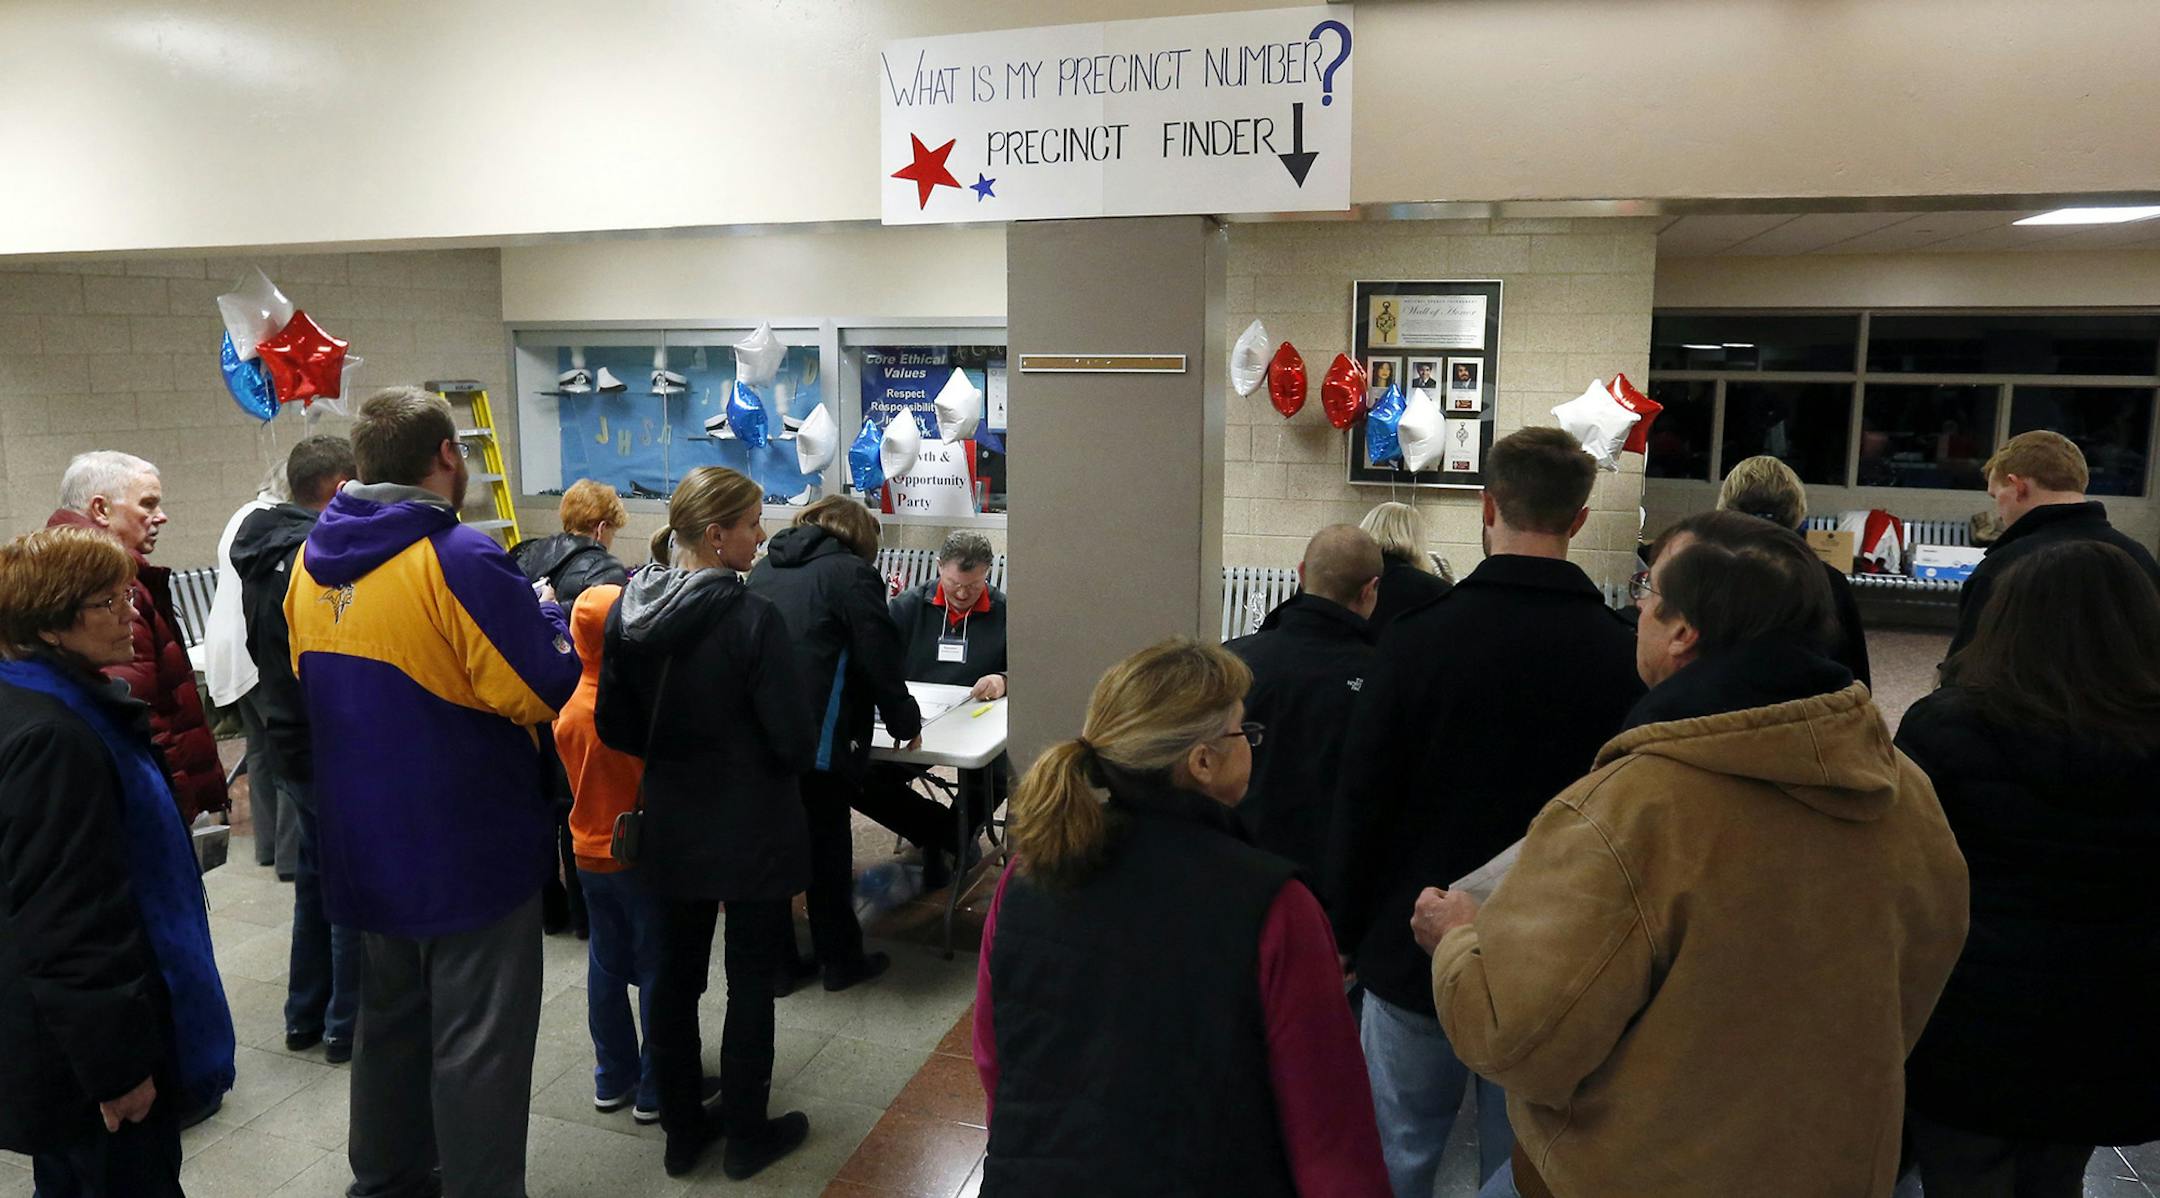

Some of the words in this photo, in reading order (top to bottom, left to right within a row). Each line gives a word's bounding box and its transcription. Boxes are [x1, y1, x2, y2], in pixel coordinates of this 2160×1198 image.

[881, 49, 961, 106] WHAT
[973, 65, 995, 102] IS
[1006, 61, 1043, 100] MY
[1058, 49, 1191, 96] PRECINCT
[987, 124, 1129, 166] PRECINCT
[1163, 117, 1277, 158] FINDER
[866, 354, 896, 365] Core
[900, 353, 946, 365] Ethical
[884, 367, 927, 378] Values
[886, 388, 926, 400] Respect
[897, 493, 930, 510] Party
